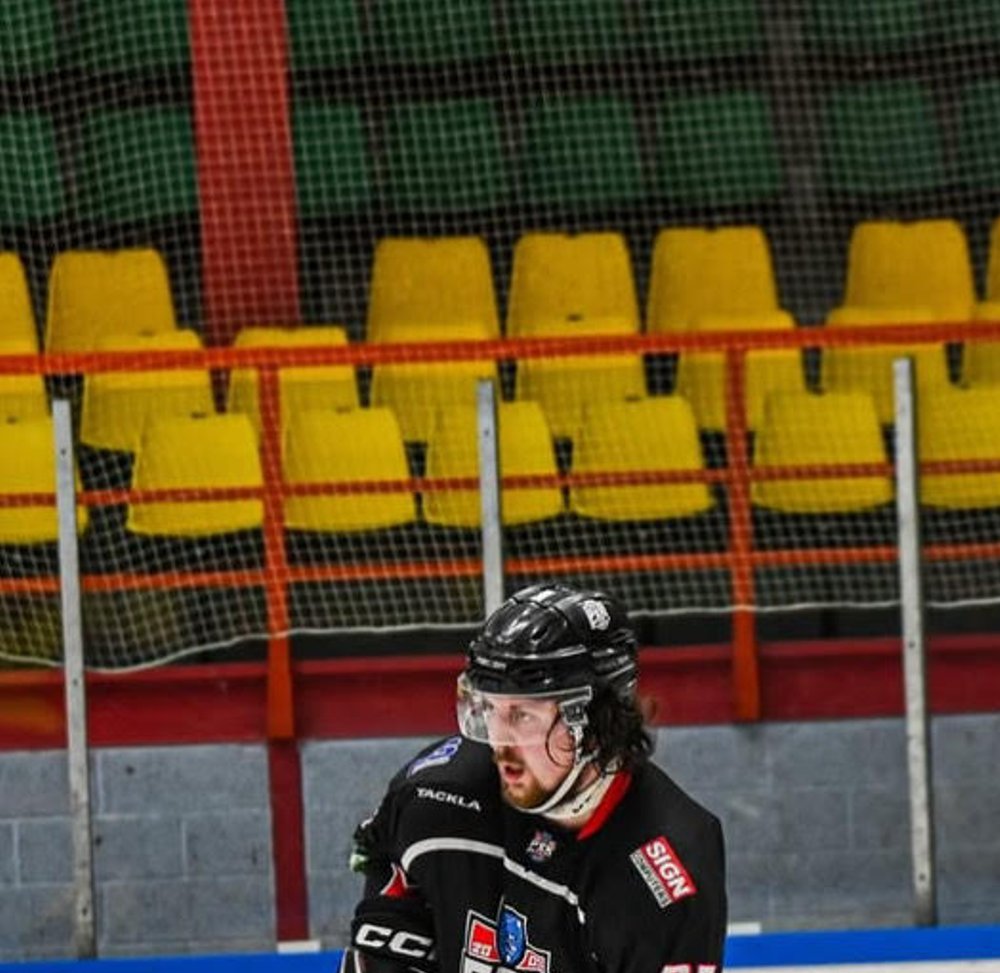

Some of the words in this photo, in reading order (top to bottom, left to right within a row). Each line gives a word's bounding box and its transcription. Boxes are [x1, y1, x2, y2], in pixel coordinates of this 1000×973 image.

[416, 787, 482, 813] TACKLA
[645, 839, 696, 900] SIGN
[355, 923, 436, 960] CC
